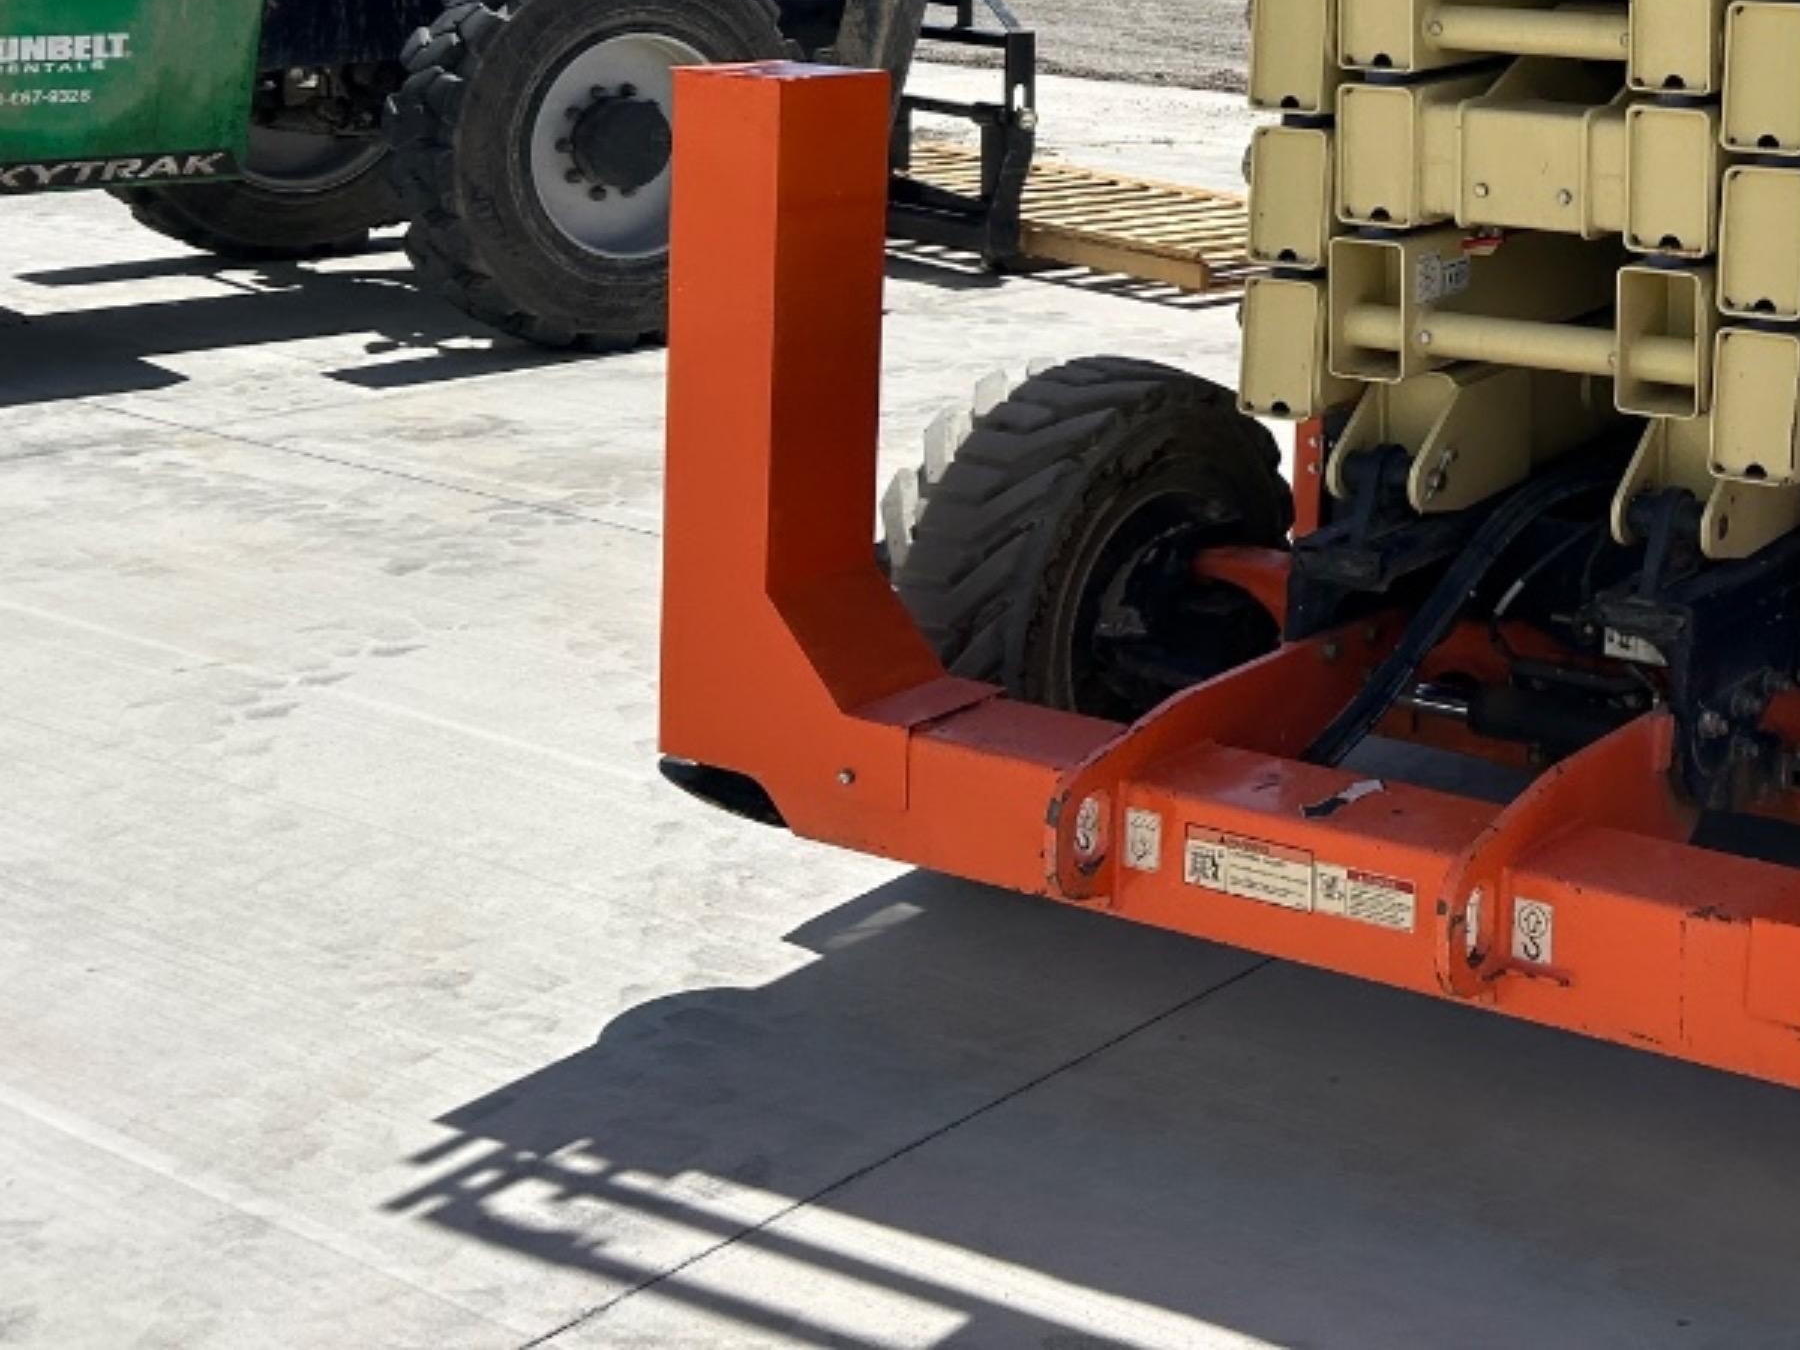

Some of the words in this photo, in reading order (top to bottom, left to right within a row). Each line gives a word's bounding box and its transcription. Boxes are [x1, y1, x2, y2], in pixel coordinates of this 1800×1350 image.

[0, 32, 130, 63] UNBELT
[0, 59, 106, 75] ENTALS
[0, 152, 225, 187] KYTRAK
